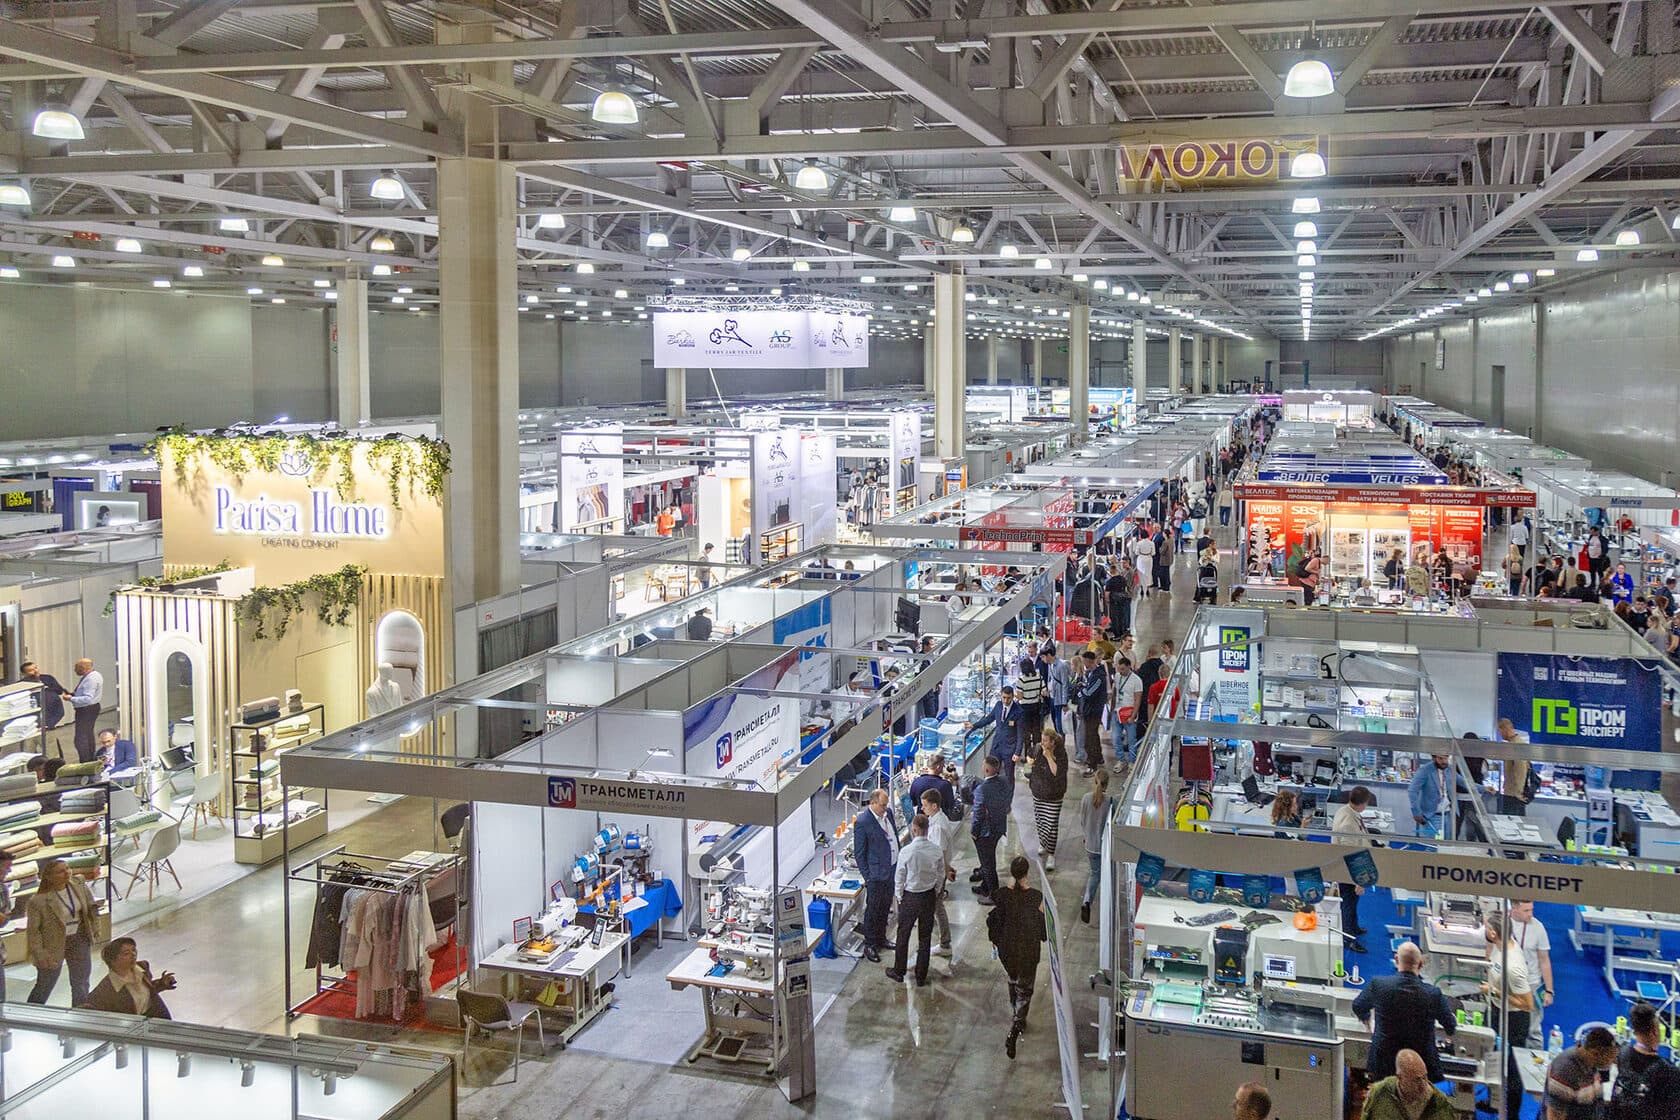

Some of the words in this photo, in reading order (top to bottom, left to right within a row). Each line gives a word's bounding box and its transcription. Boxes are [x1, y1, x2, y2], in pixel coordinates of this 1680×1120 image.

[1281, 473, 1330, 483] ВЕЛЛЕС
[1371, 474, 1419, 485] VELLES
[9, 497, 32, 507] GRAPH
[1610, 497, 1642, 505] Minerva
[216, 487, 298, 532] Parisa
[312, 490, 385, 535] Home
[1291, 505, 1319, 515] SBS
[982, 530, 1046, 542] TechnoPrint
[261, 539, 300, 549] CREATING
[301, 540, 339, 550] COMFORT
[1222, 650, 1248, 660] ПРОМ
[1579, 708, 1626, 727] ПРОМ
[734, 704, 781, 743] ТРАНСМЕТАЛЛ
[1579, 726, 1625, 738] ЭКСПЕРТ
[581, 783, 686, 802] ТРАНСМЕТАЛЛ
[1422, 865, 1583, 893] ПРОМЭКСПЕРТ
